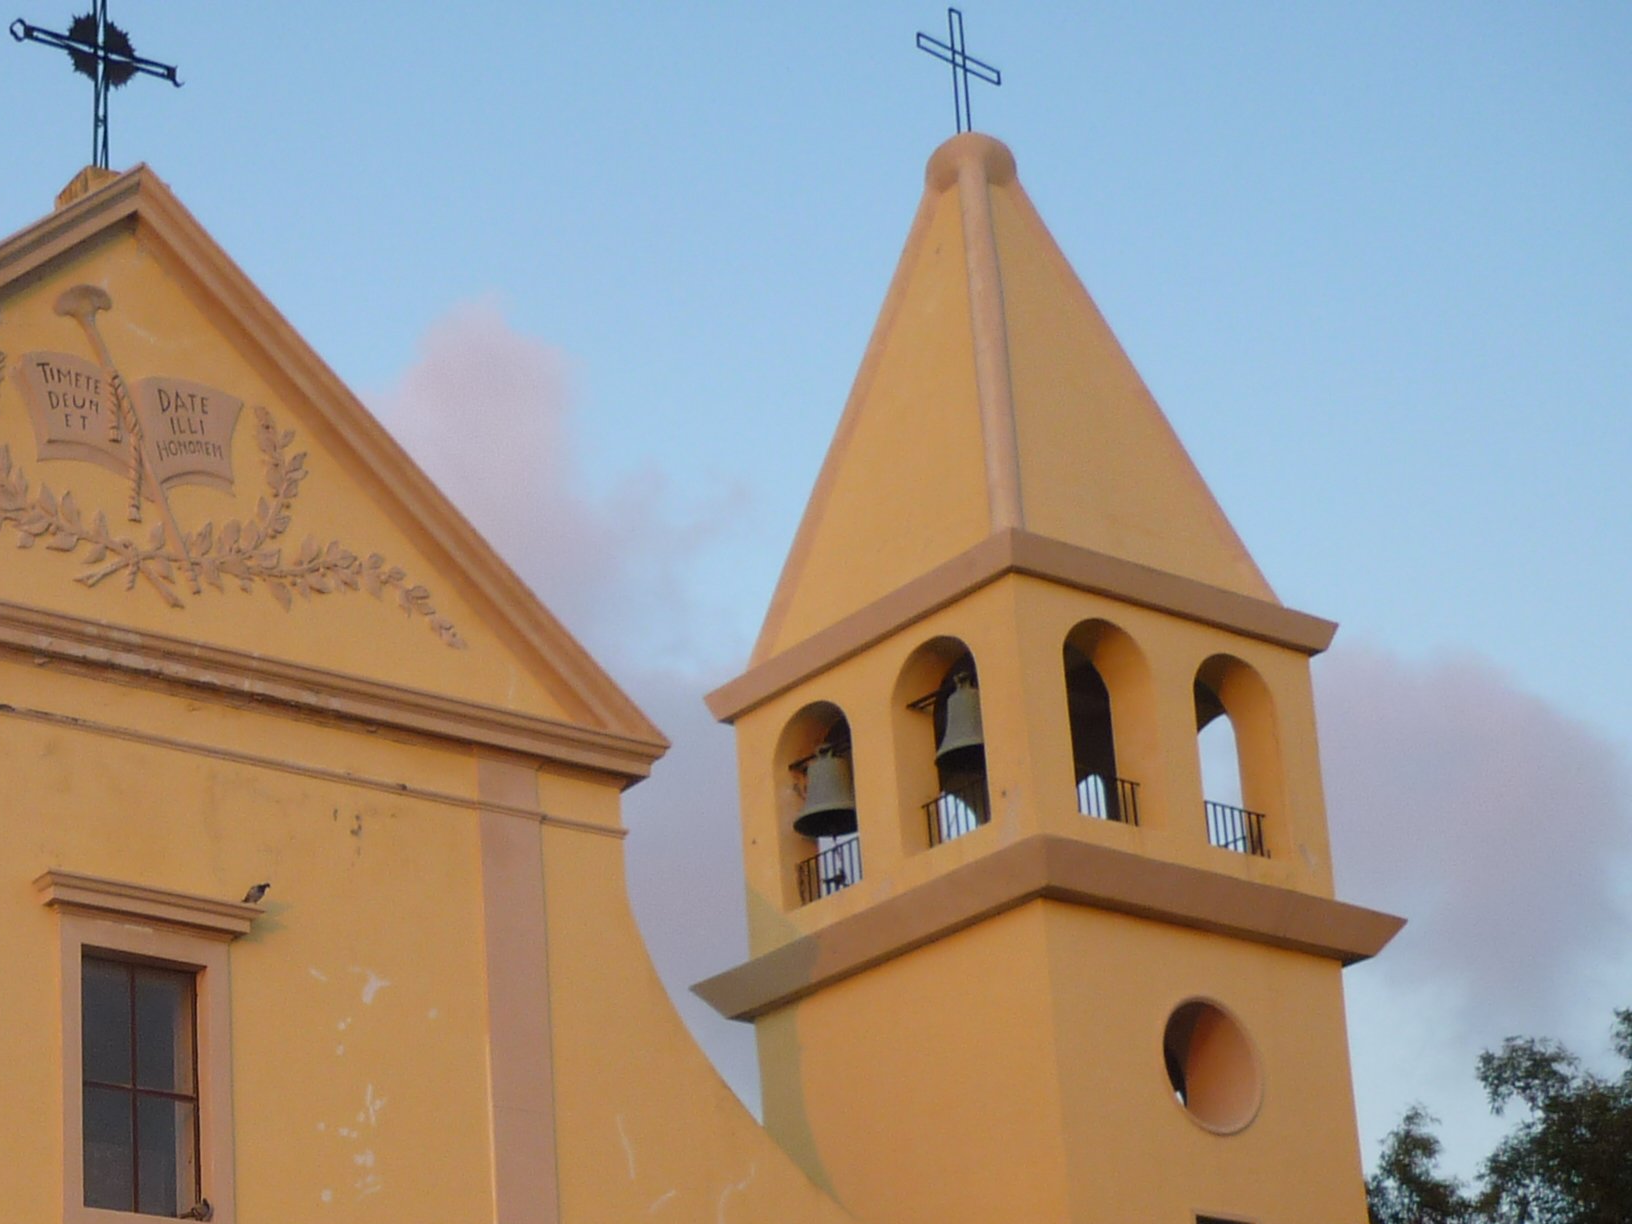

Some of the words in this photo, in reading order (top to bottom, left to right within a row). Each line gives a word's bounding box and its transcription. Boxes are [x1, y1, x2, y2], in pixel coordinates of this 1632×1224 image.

[35, 362, 101, 395] TIMETE
[48, 391, 99, 415] DEUM
[157, 388, 209, 415] DATE
[64, 413, 89, 431] ET
[169, 416, 206, 436] ILLI
[155, 440, 225, 461] HONOREM
